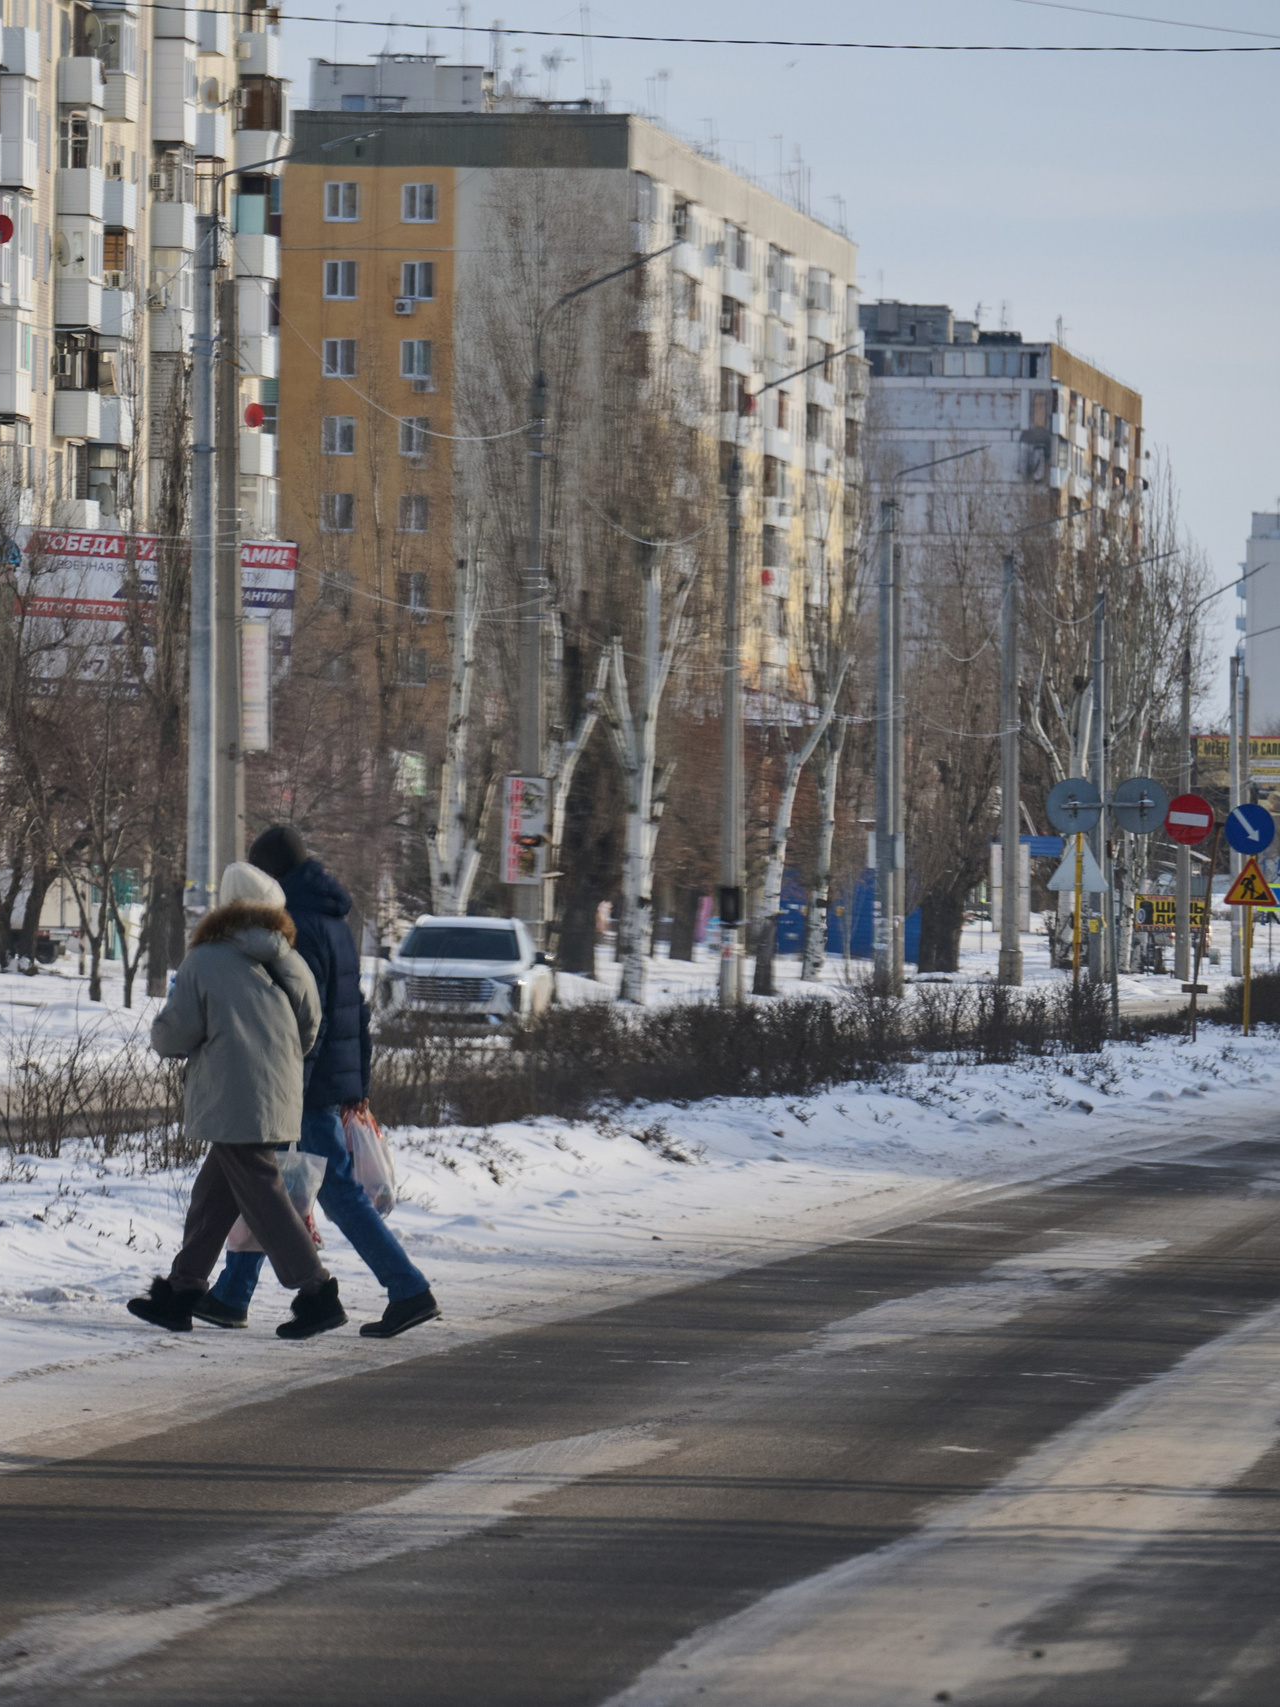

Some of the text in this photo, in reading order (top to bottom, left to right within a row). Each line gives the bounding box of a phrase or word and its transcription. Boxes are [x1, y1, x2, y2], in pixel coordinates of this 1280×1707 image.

[40, 535, 119, 555] ПОБЕДА
[241, 547, 289, 565] АМИ!
[58, 560, 113, 572] ВОЕННАЯ
[1261, 742, 1280, 755] САЛ
